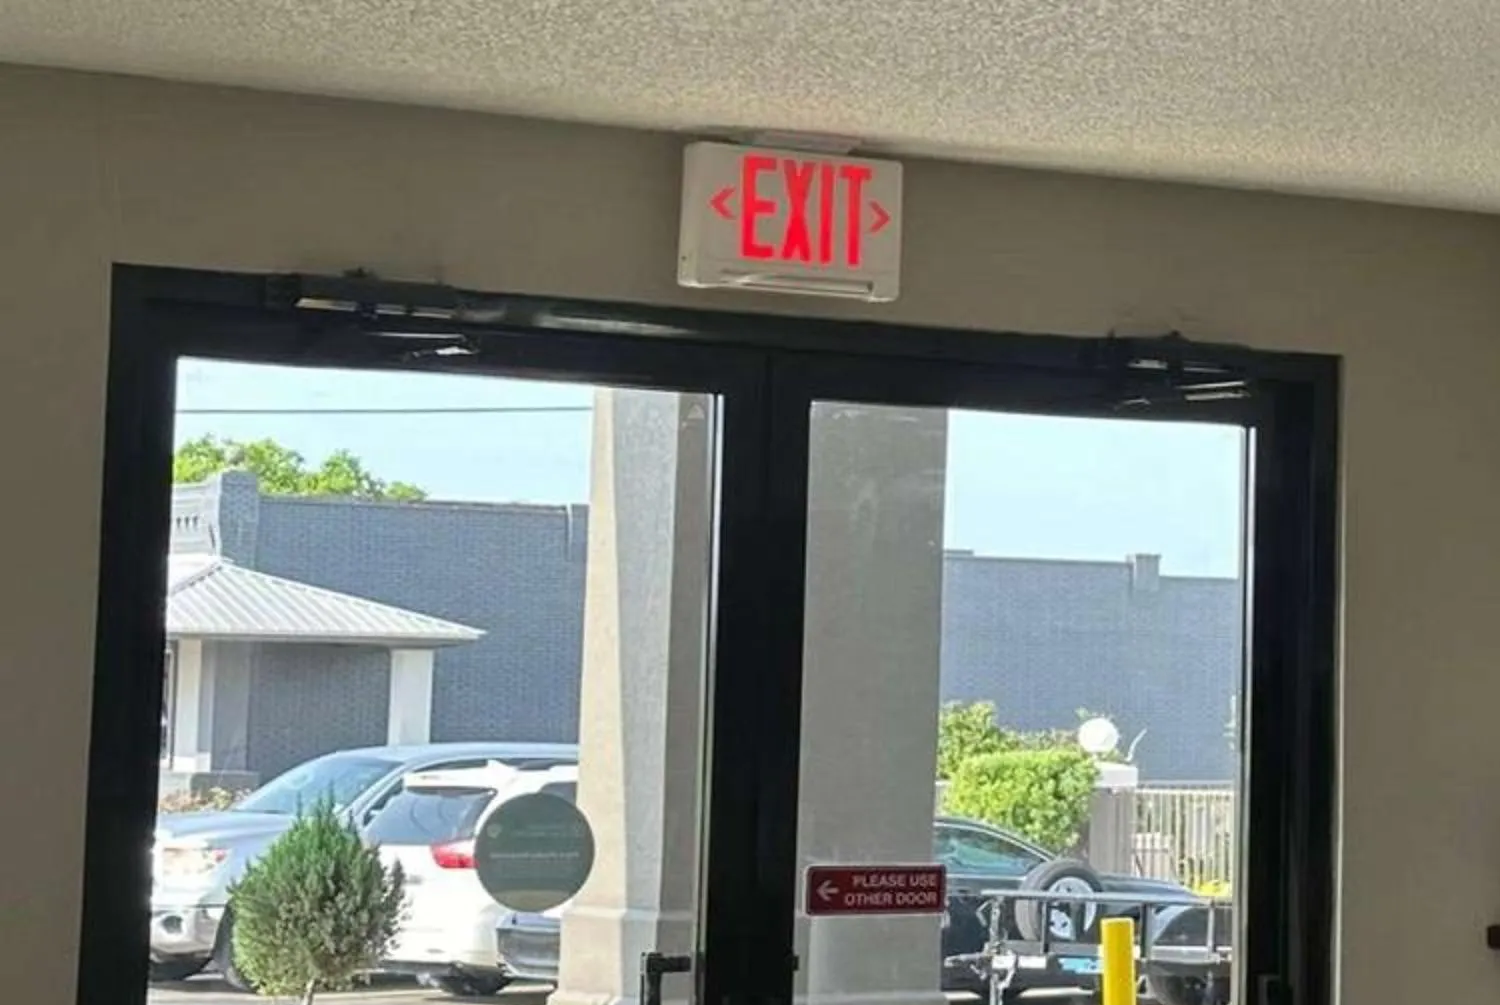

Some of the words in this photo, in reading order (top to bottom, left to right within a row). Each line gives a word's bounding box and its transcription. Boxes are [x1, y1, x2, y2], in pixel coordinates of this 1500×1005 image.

[741, 154, 873, 267] EXIT
[851, 873, 906, 887] PLEASE
[909, 873, 938, 887] USE
[844, 891, 893, 906] OTHER
[895, 891, 938, 905] DOOR
